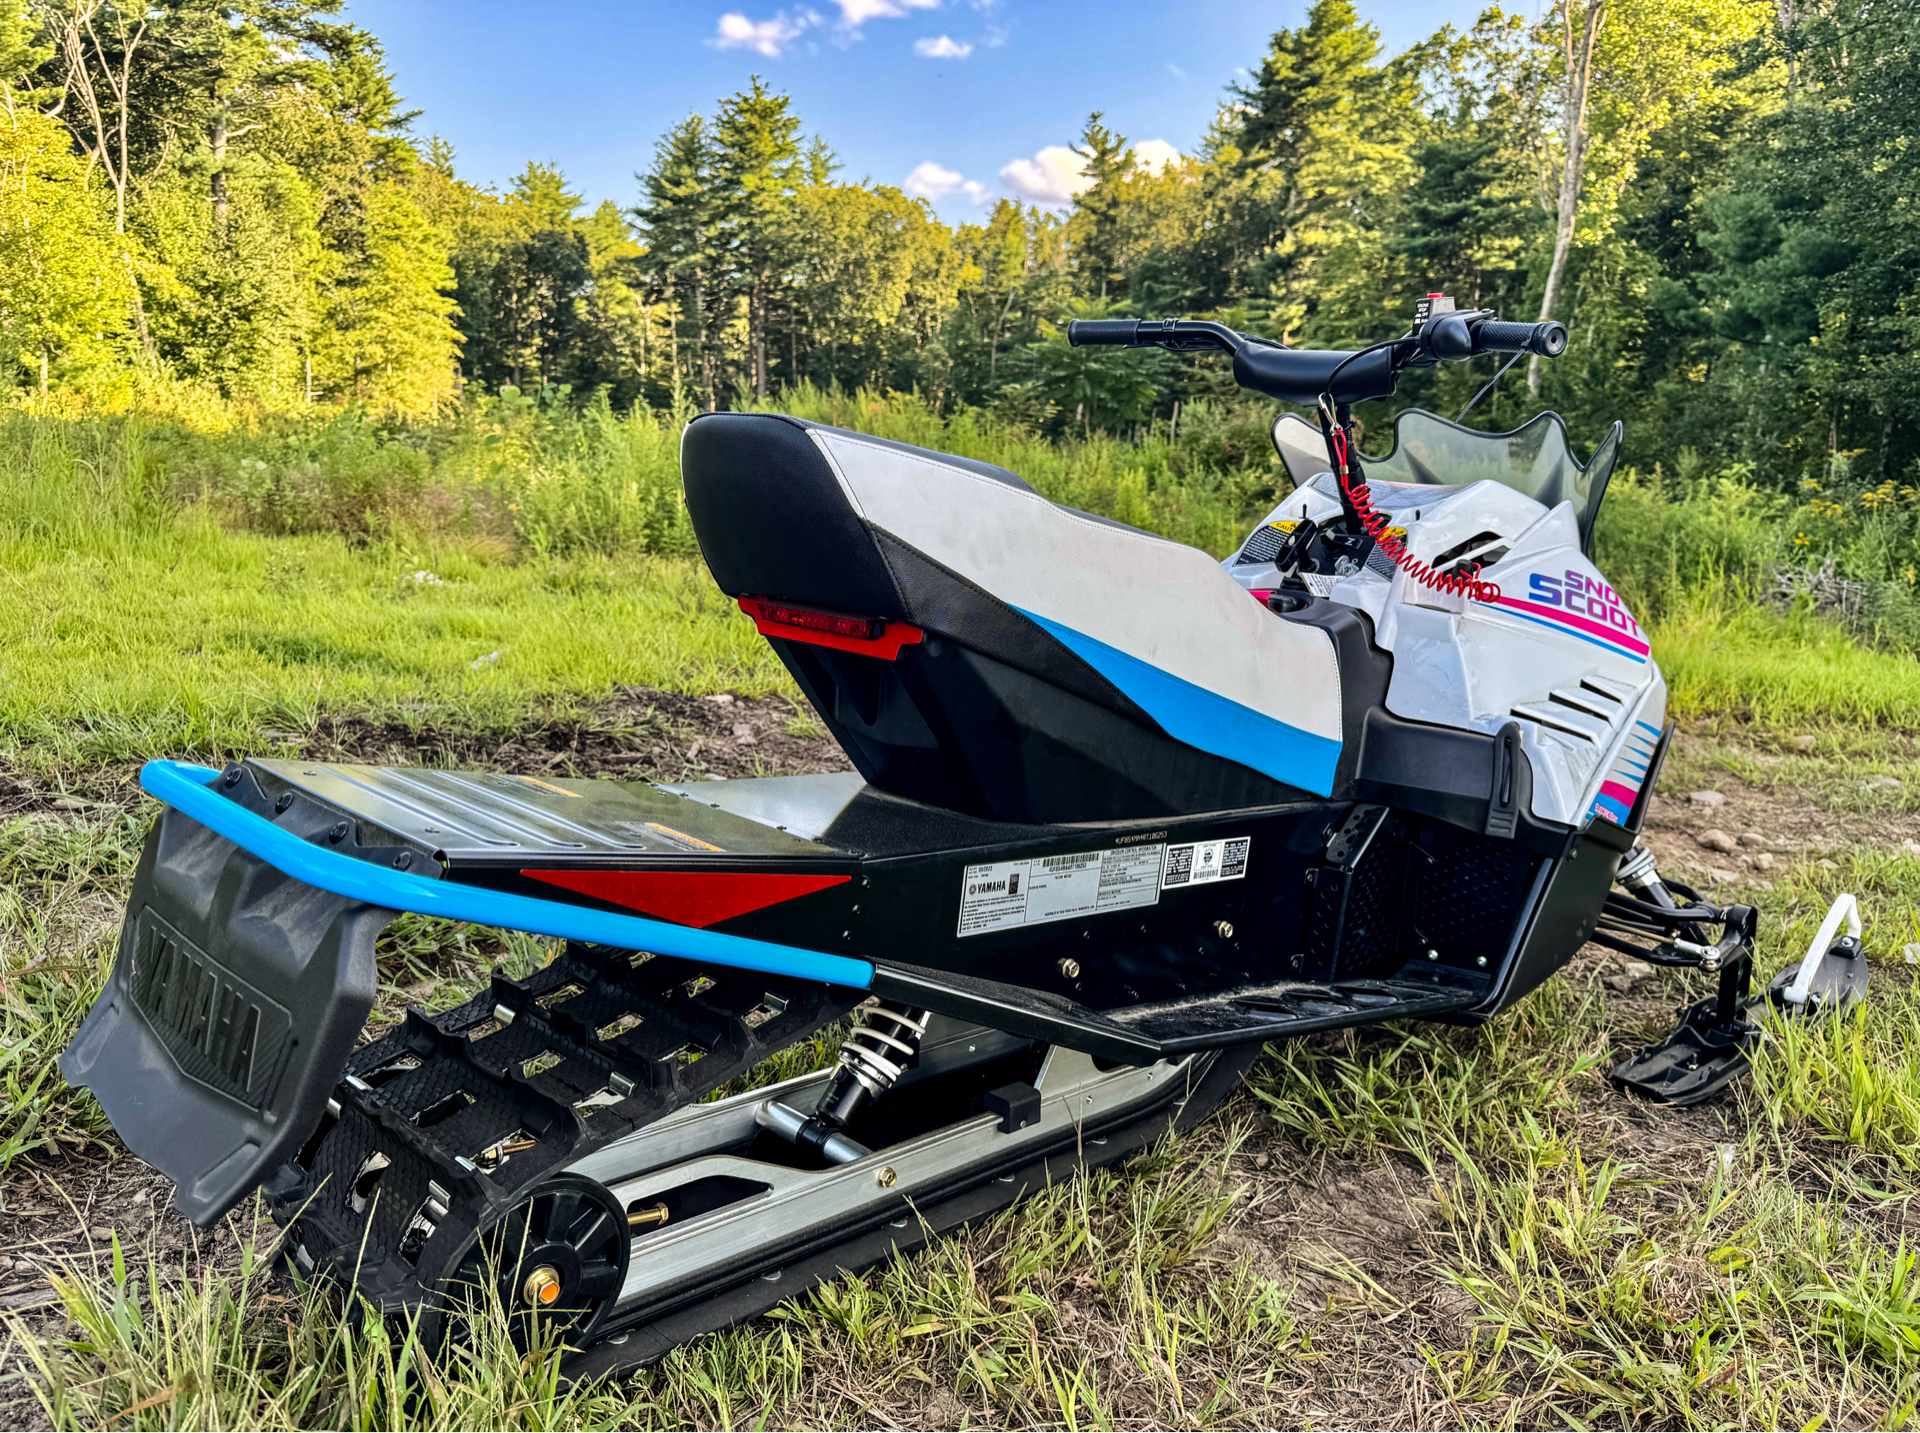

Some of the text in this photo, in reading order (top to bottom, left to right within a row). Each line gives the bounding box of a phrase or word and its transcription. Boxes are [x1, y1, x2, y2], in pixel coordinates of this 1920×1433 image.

[1276, 522, 1295, 534] CAUT
[1528, 572, 1640, 638] SCOOT
[1564, 569, 1620, 608] SNO
[977, 880, 1006, 894] YAMAHA
[141, 925, 261, 1094] YAMAHA
